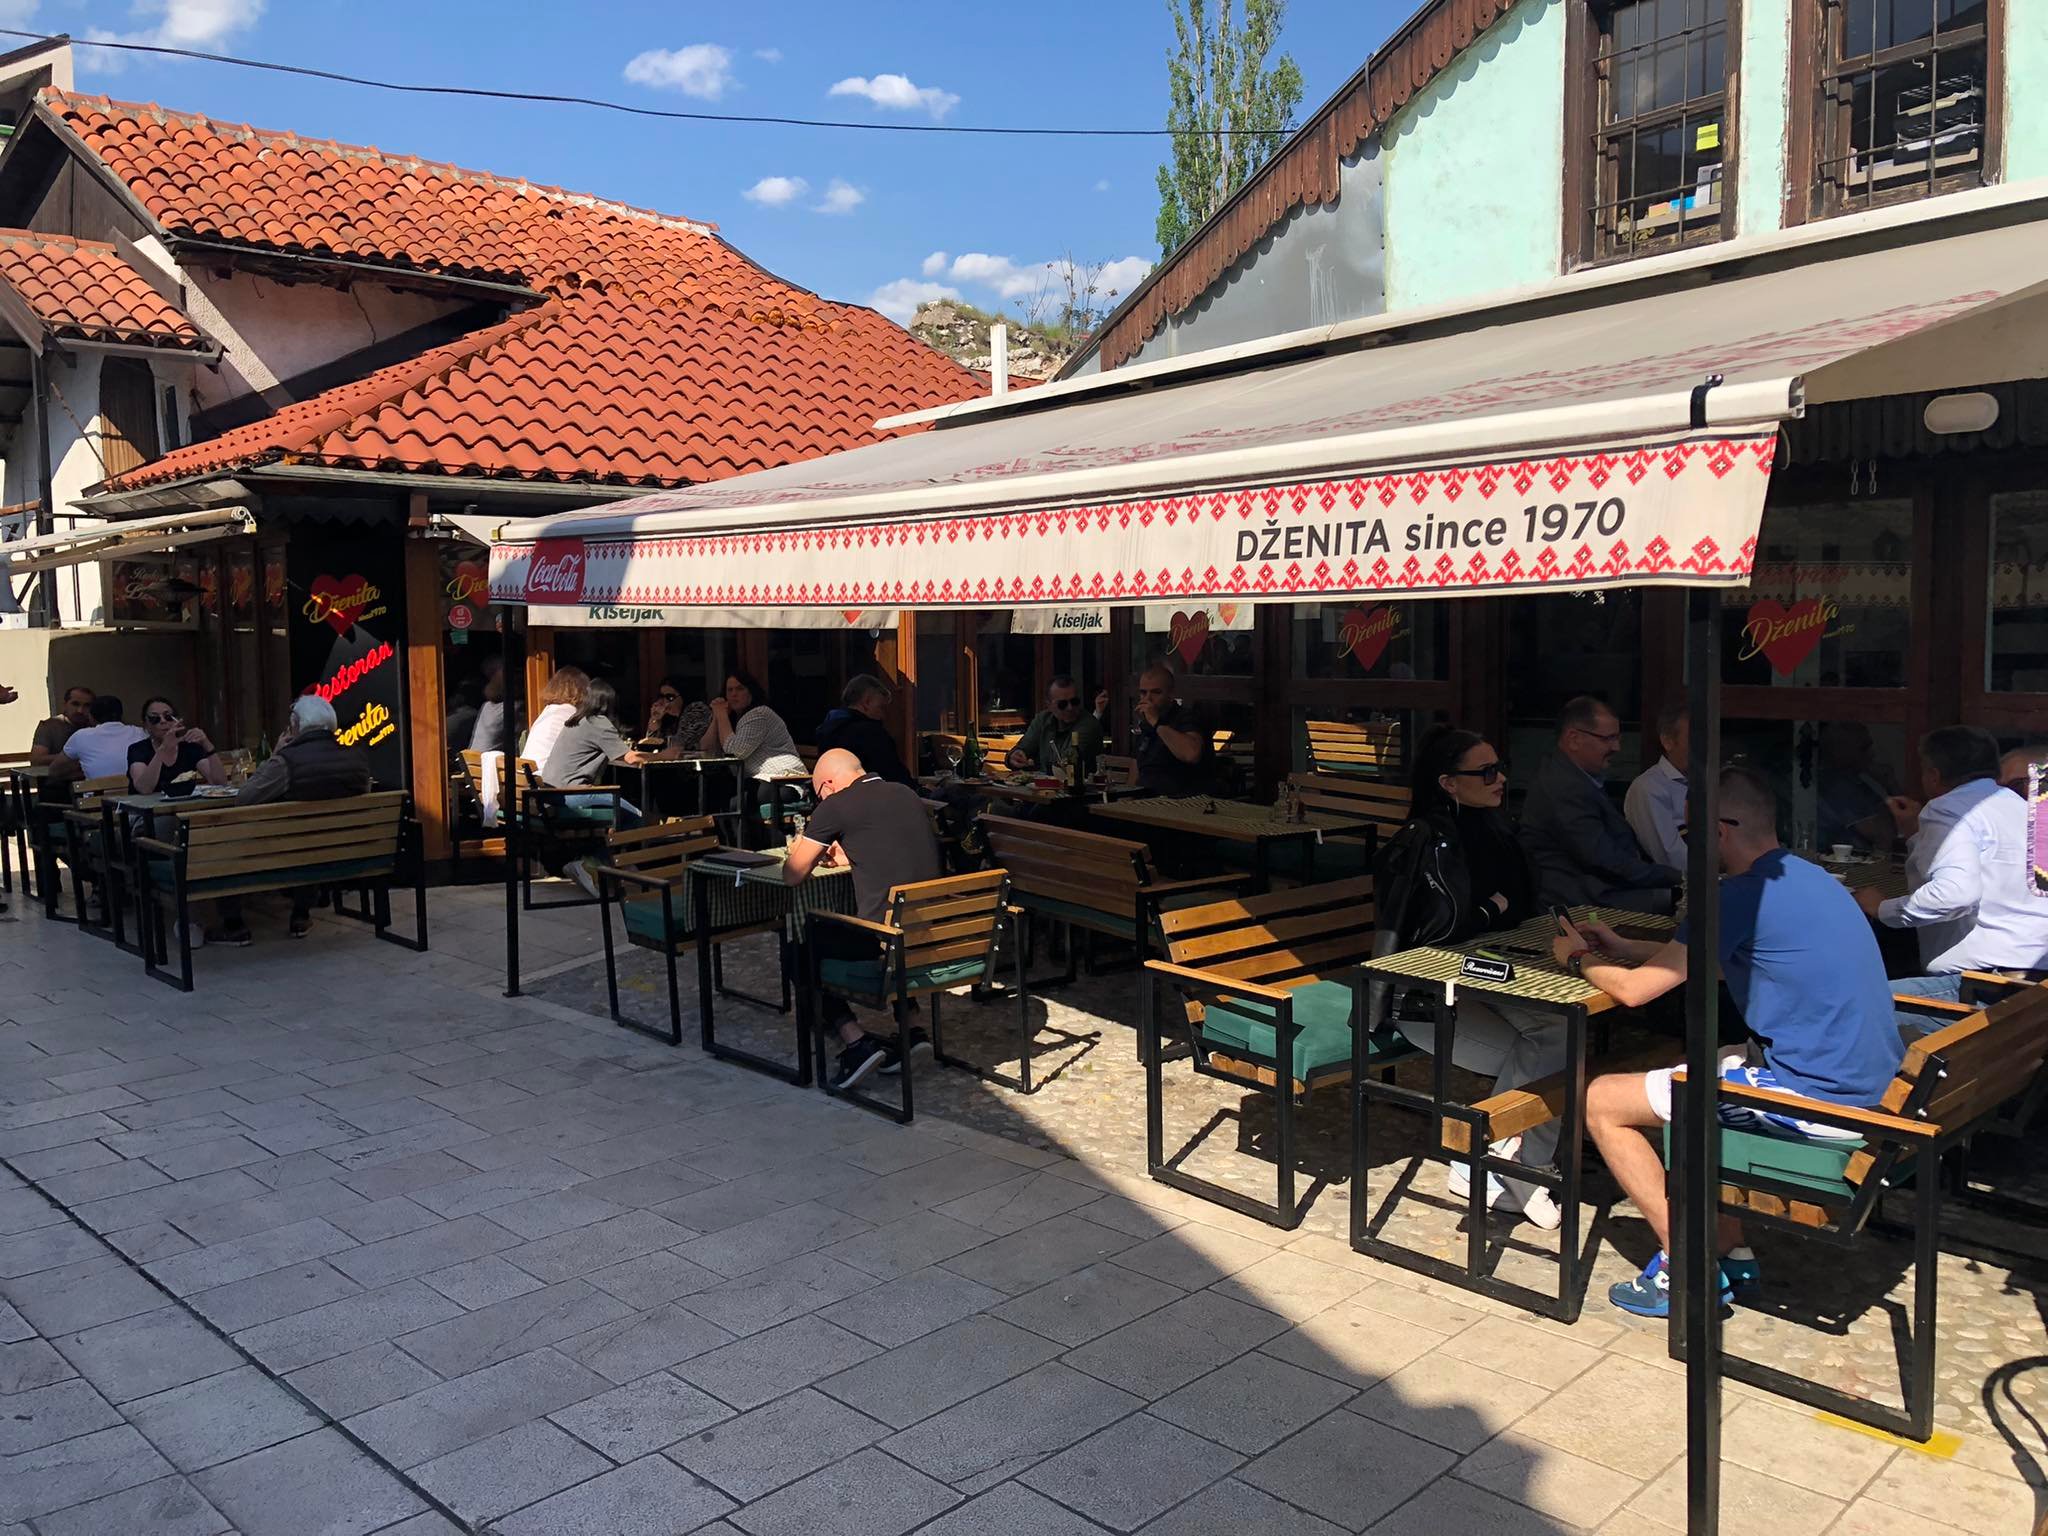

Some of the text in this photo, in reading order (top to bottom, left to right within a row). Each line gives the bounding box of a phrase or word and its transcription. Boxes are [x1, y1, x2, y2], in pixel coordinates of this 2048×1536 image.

[1235, 496, 1627, 562] DŽENITA since 1970
[1053, 612, 1103, 630] kiseljak
[1738, 595, 1840, 661] Dženita
